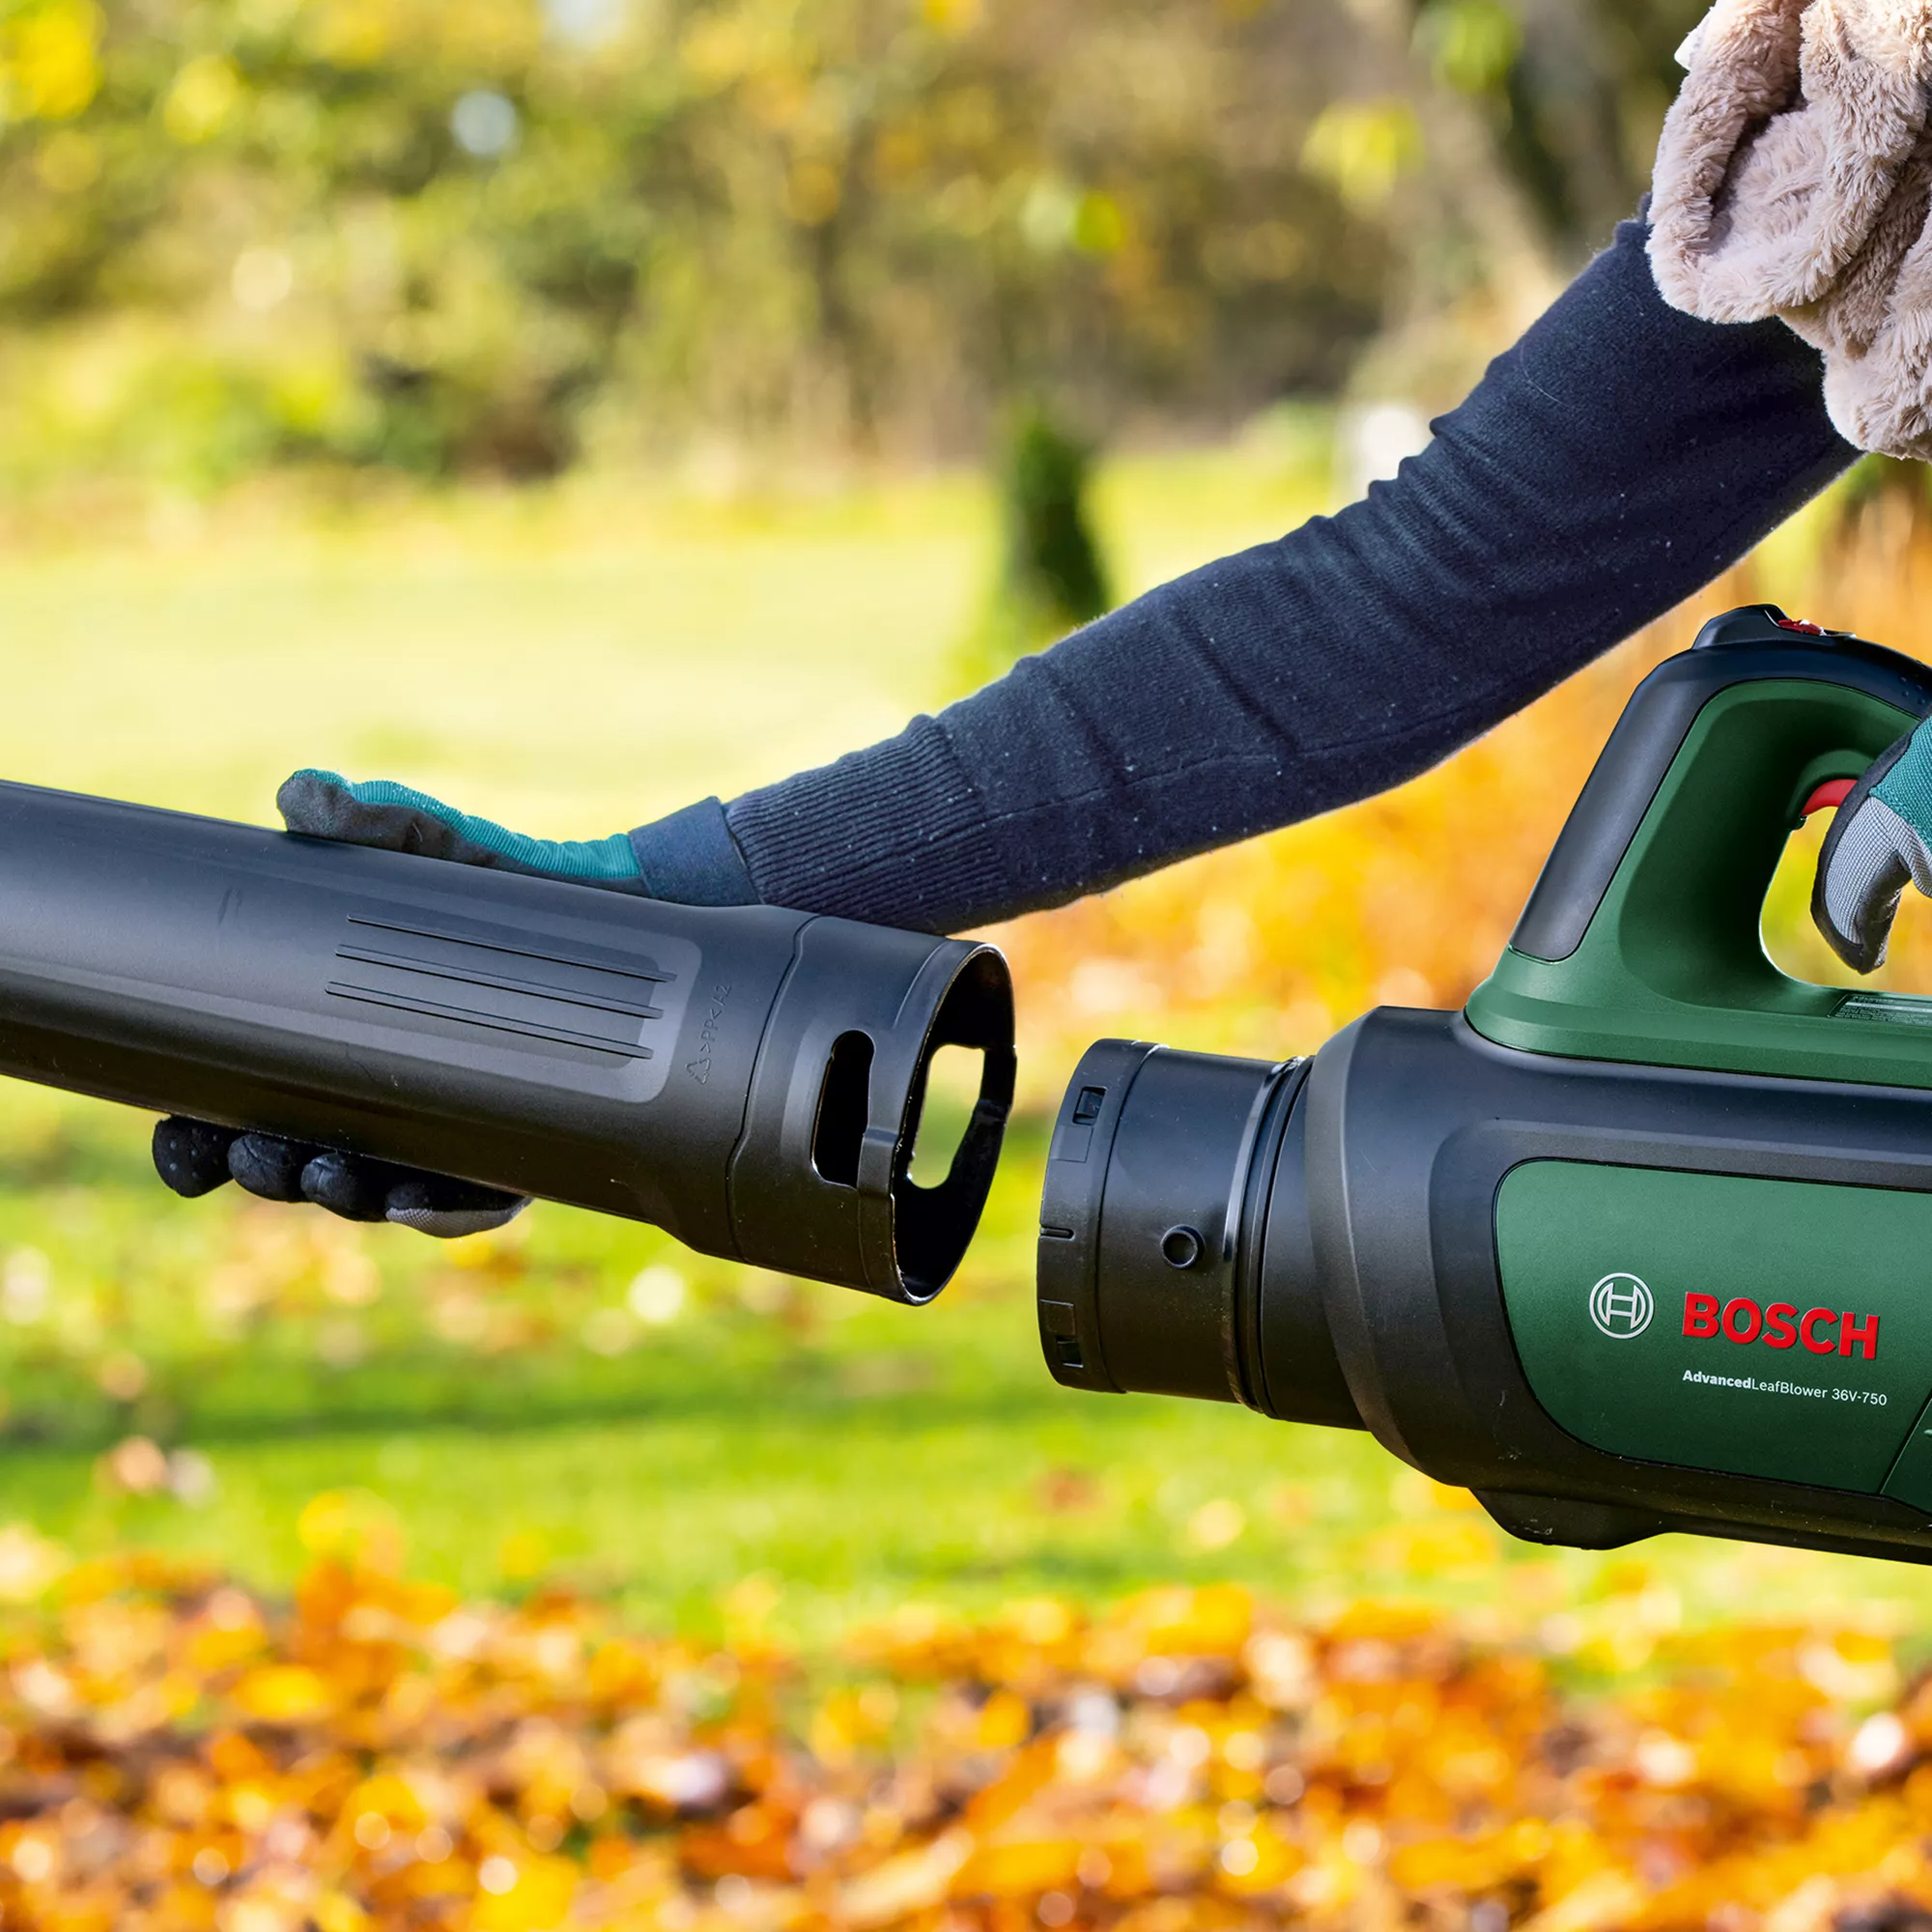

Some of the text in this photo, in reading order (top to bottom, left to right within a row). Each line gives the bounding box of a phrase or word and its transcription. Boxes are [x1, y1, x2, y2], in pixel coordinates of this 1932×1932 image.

[1682, 1292, 1880, 1360] BOSCH
[1682, 1369, 1888, 1406] AdvancedLeafBlower 36V-750
